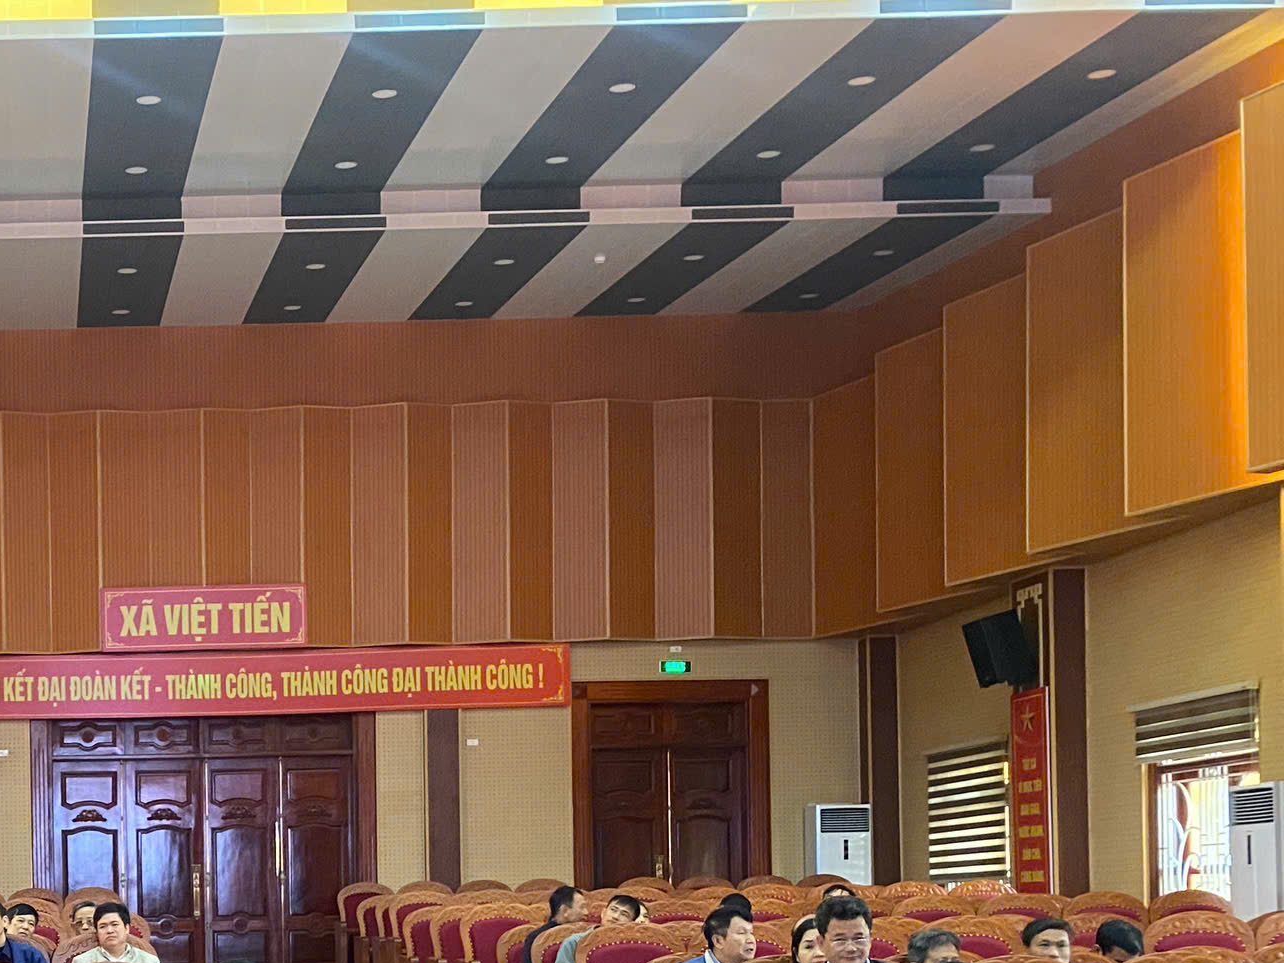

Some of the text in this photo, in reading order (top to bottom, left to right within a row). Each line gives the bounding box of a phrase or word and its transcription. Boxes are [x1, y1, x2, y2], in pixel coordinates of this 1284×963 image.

[119, 591, 291, 642] XÃ VIỆT TIẾN
[3, 668, 33, 702] KẾT
[38, 676, 66, 707] ĐẠI
[70, 670, 116, 701] ĐOÀN
[120, 666, 151, 700] KẾT
[165, 668, 221, 700] THÀNH
[225, 668, 277, 701] CÔNG,
[281, 665, 337, 697] THÀNH
[341, 663, 388, 695] CÔNG
[392, 667, 421, 698] ĐẠI
[425, 660, 481, 692] THÀNH
[485, 658, 533, 689] CÔNG
[538, 663, 544, 688] !
